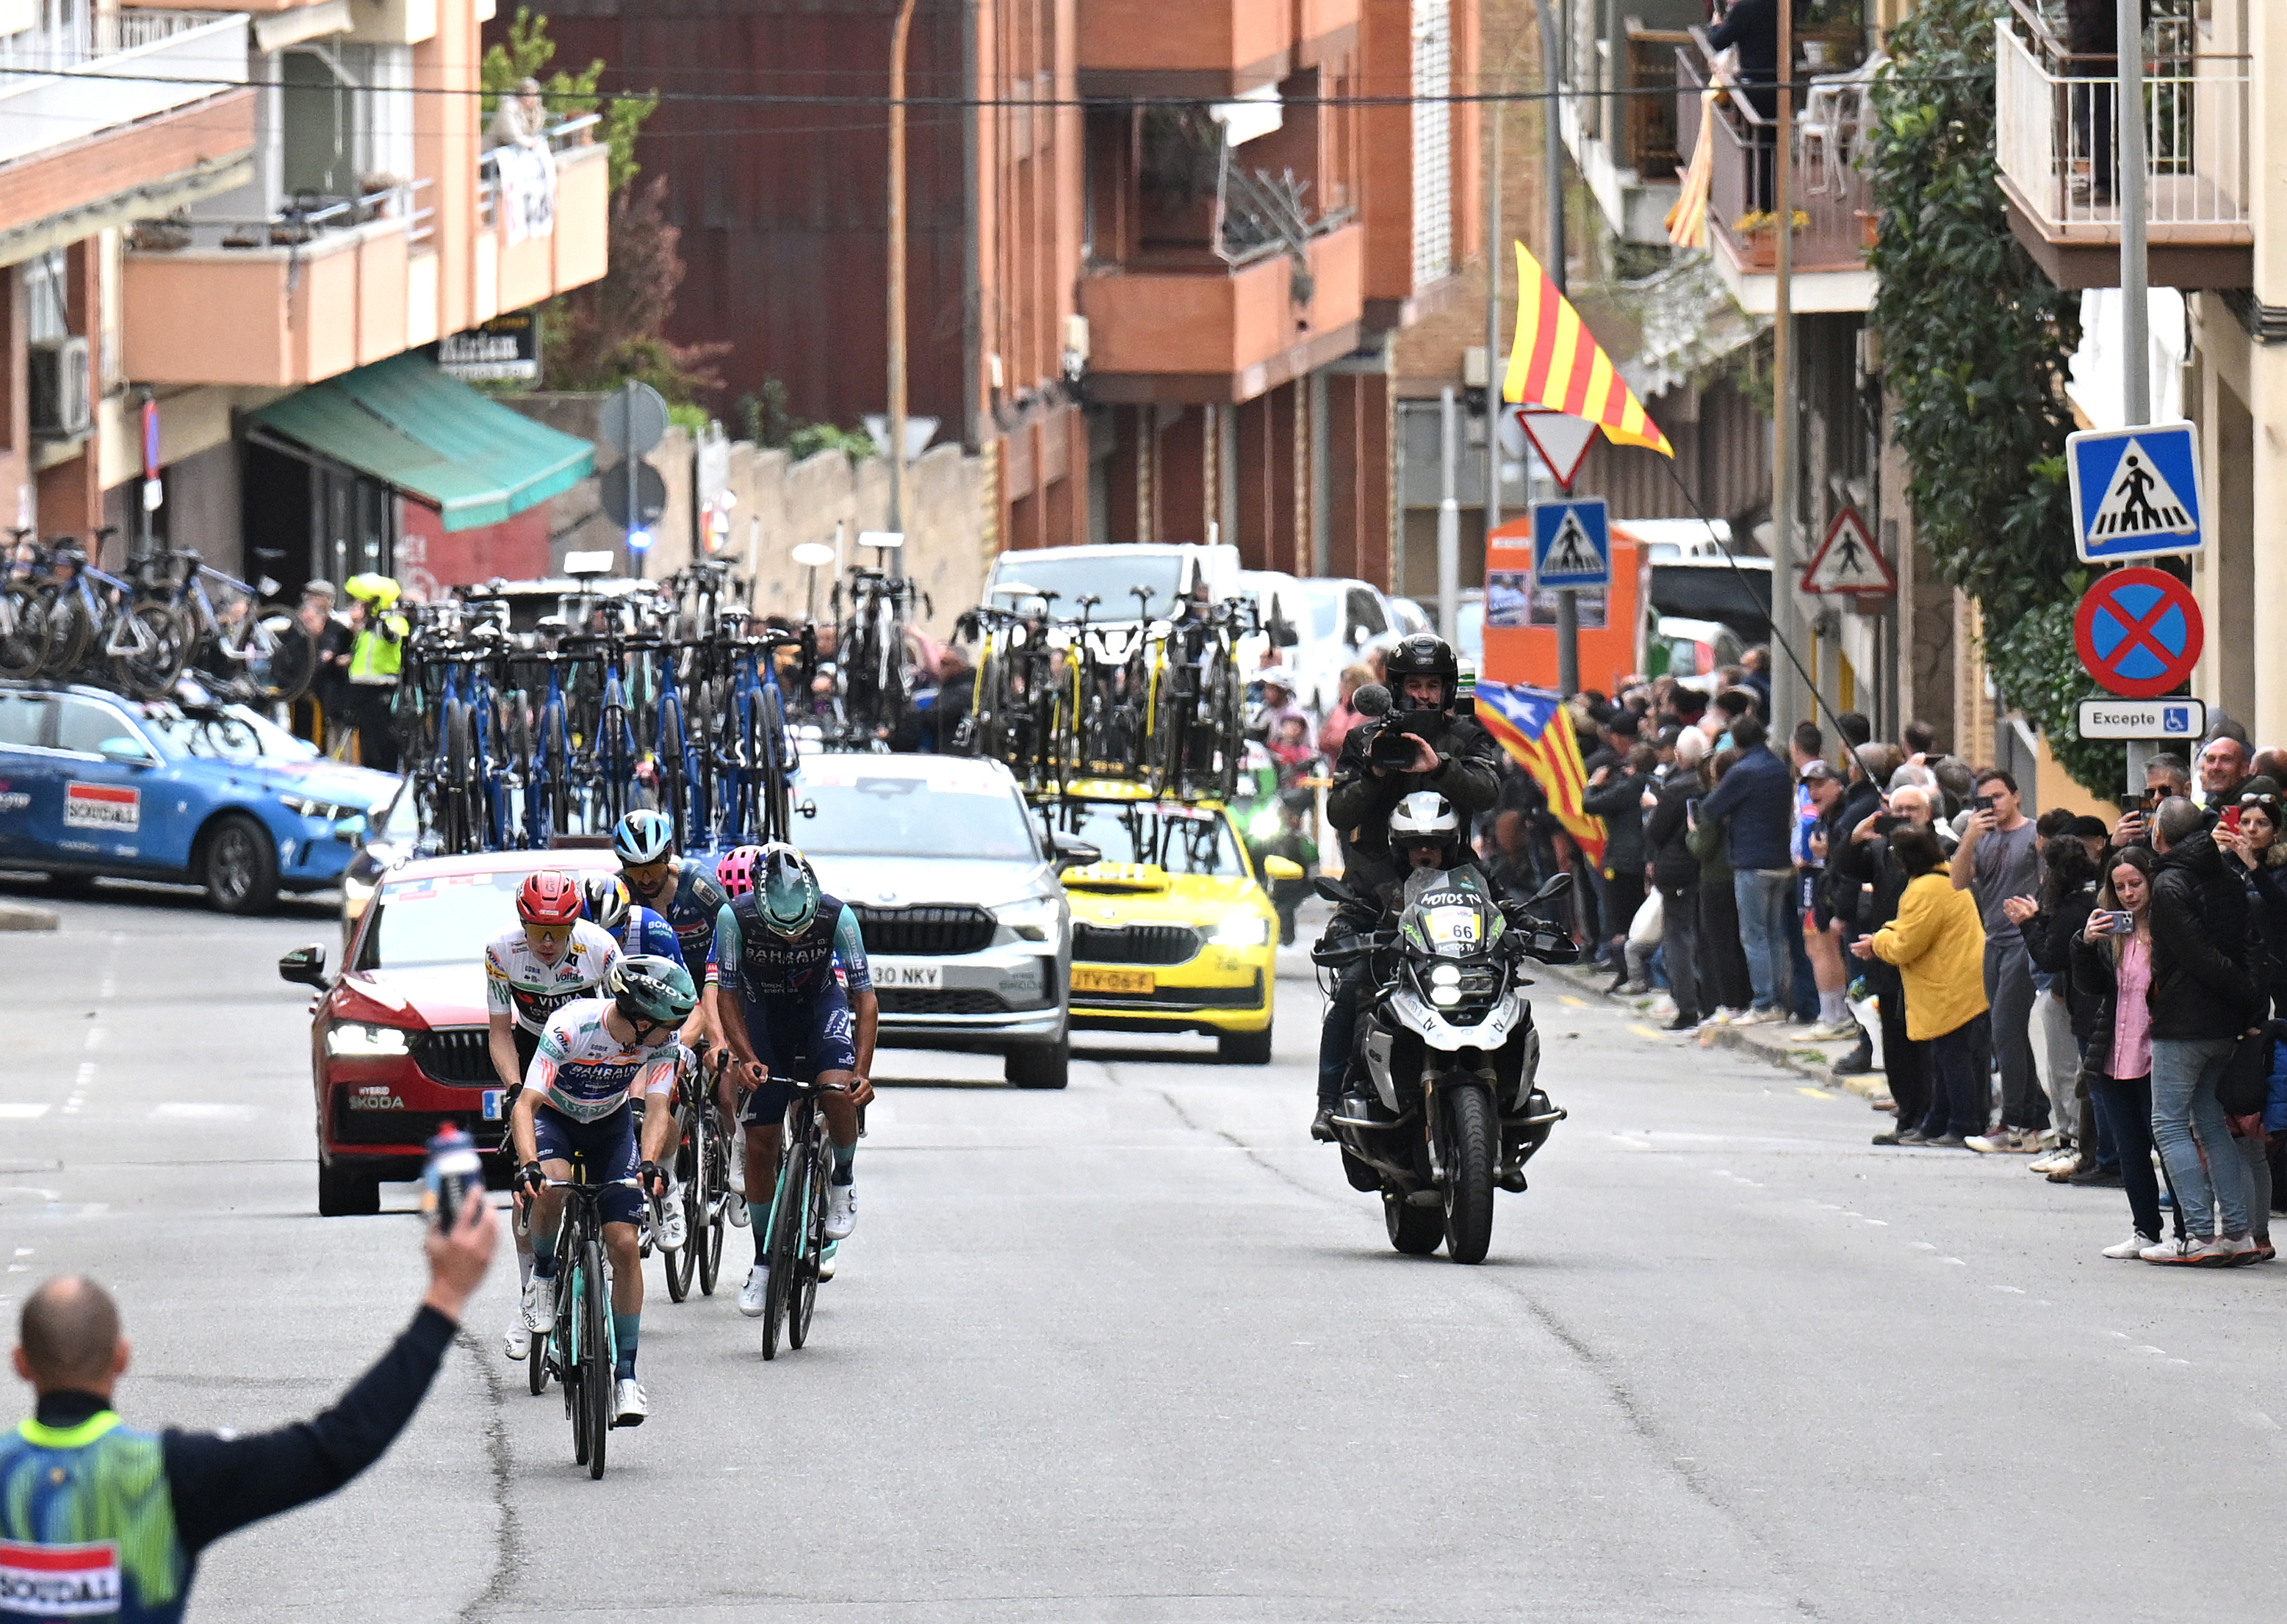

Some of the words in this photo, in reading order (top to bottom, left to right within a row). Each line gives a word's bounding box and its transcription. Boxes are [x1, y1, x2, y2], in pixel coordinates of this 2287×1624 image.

[2092, 712, 2155, 726] Excepte
[69, 802, 137, 823] SOUDAL
[1420, 892, 1464, 906] MOTOS
[1466, 893, 1483, 905] TV
[648, 921, 674, 934] BORA
[1452, 924, 1473, 939] 66
[724, 926, 734, 971] Bianchi
[746, 947, 827, 961] BAHRAIN
[845, 925, 865, 970] Bianchi
[1438, 943, 1465, 953] MOTOS
[1465, 944, 1475, 953] TV
[555, 971, 580, 983] Volta
[640, 974, 684, 1001] RUDY
[539, 992, 583, 1008] VISMA
[1422, 1017, 1437, 1032] tv
[572, 1065, 639, 1078] BAHRAIN
